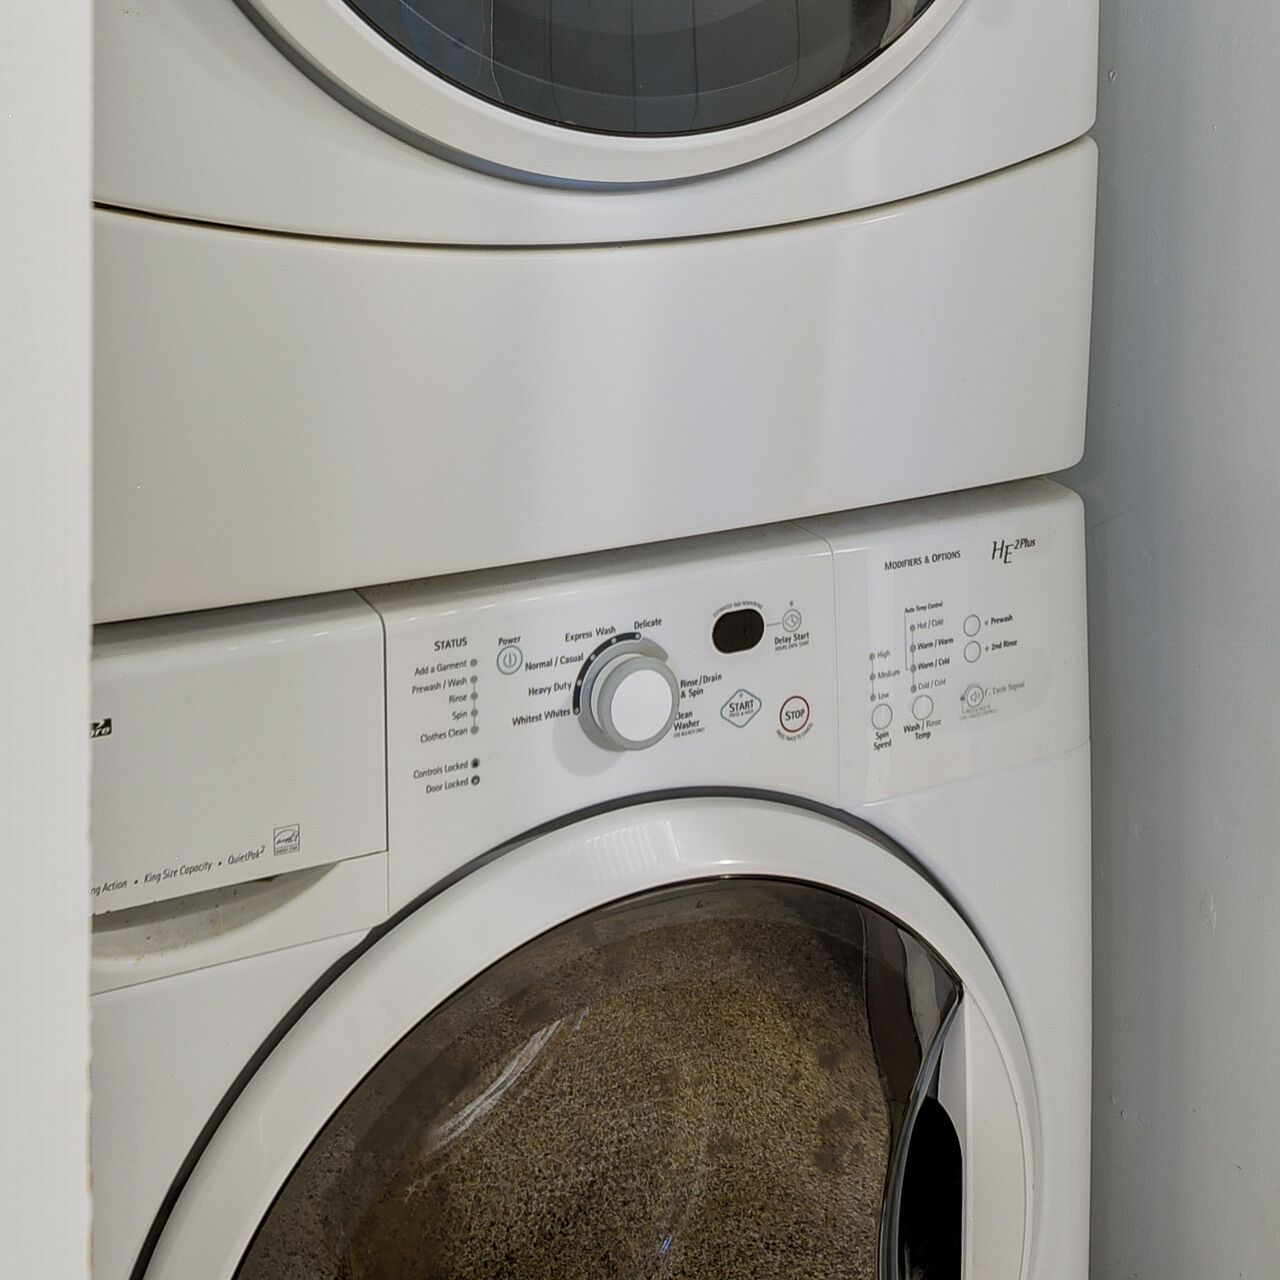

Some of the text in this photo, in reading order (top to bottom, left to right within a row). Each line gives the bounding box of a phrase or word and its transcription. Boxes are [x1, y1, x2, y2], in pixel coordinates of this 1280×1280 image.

[885, 550, 961, 571] MODIFIERS & OPTIONS
[928, 601, 944, 610] Control
[634, 618, 663, 630] Delicate
[917, 622, 927, 630] Hot
[931, 618, 944, 628] Cold
[990, 614, 1014, 626] Prewash
[498, 636, 521, 647] Power
[565, 626, 616, 644] Express Wash
[775, 632, 810, 646] Delay Start
[434, 637, 468, 652] STATUS
[917, 642, 934, 651] Warm
[938, 638, 954, 647] Warm
[991, 639, 1018, 651] 2nd Rinse
[877, 650, 891, 660] High
[415, 667, 431, 677] Add
[437, 660, 467, 673] Garment
[525, 658, 553, 672] Normal
[560, 653, 584, 666] Casual
[917, 661, 934, 671] Warm
[939, 657, 951, 666] Cold
[877, 669, 901, 680] Medium
[412, 682, 442, 695] Prewash
[448, 677, 468, 689] Wash
[528, 680, 572, 697] Heavy Duty
[918, 682, 930, 691] Cold
[934, 678, 947, 688] Cold
[449, 694, 468, 705] Rinse
[681, 688, 704, 700] & Spin
[878, 692, 890, 700] Low
[729, 700, 754, 713] START
[452, 710, 468, 722] Spin
[512, 707, 571, 727] Whitest Whites
[785, 709, 806, 722] STOP
[674, 720, 700, 732] Washer
[903, 723, 921, 734] Wash
[926, 719, 943, 729] Rinse
[420, 727, 468, 744] Clothes Clean
[876, 730, 890, 742] Spin
[915, 730, 932, 741] Temp
[873, 739, 892, 752] Speed
[413, 761, 469, 780] Controls Locked
[426, 777, 469, 794] Door Locked
[102, 880, 128, 894] Action
[144, 872, 162, 884] King
[163, 869, 179, 880] Size
[179, 861, 213, 877] Capacity
